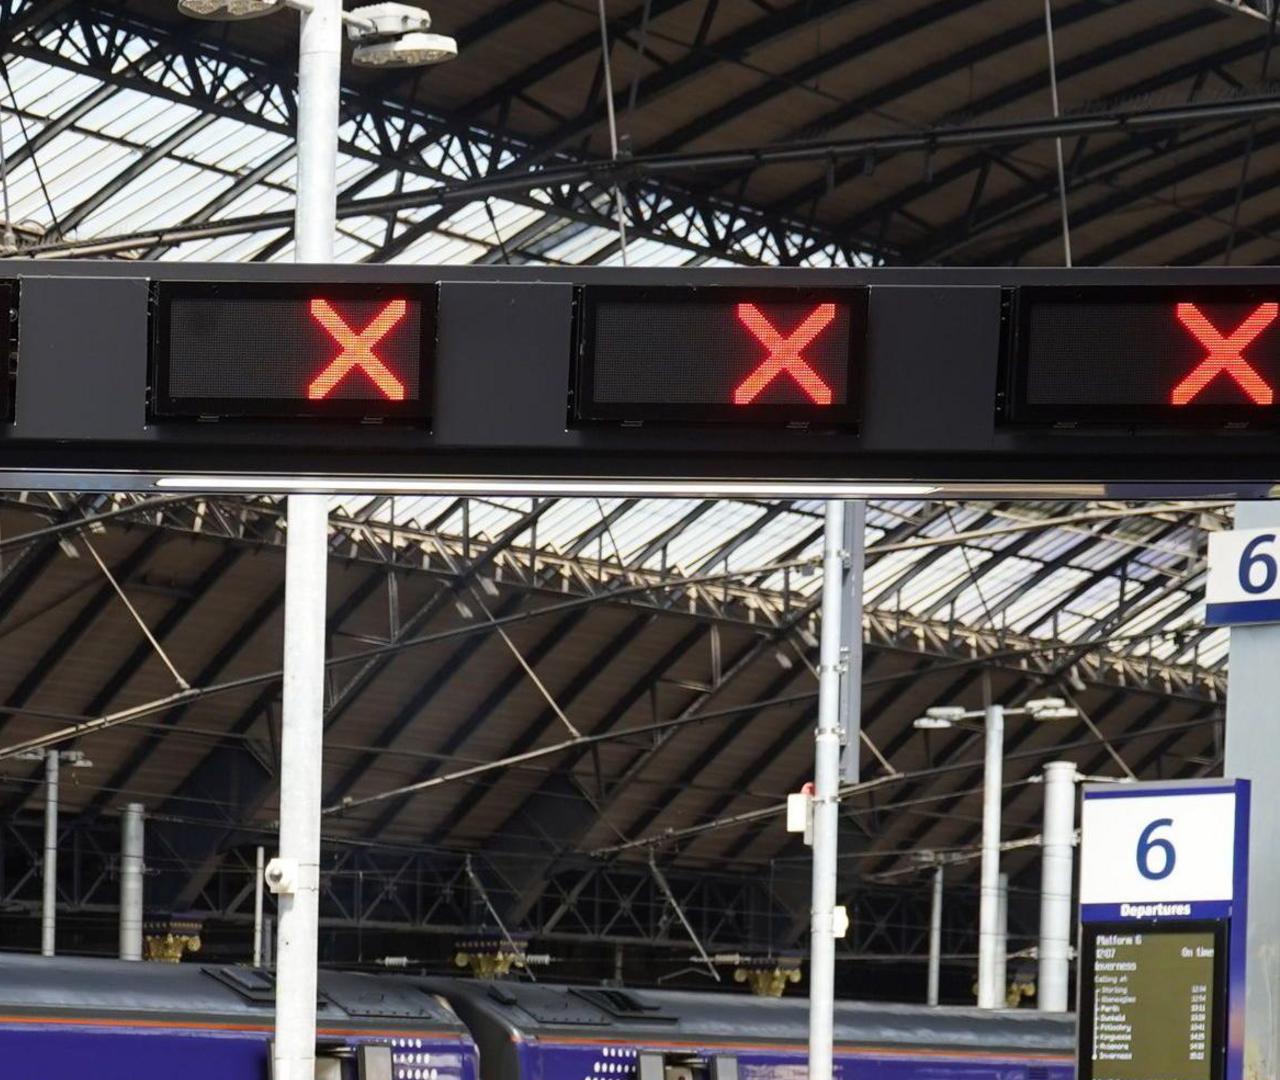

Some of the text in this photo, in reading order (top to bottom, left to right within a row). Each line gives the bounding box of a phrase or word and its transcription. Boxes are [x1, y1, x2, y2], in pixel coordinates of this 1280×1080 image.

[1239, 534, 1277, 594] 6
[1136, 818, 1176, 881] 6
[1120, 903, 1191, 919] Departures
[1096, 935, 1133, 945] Platform
[1095, 961, 1137, 971] Inverness
